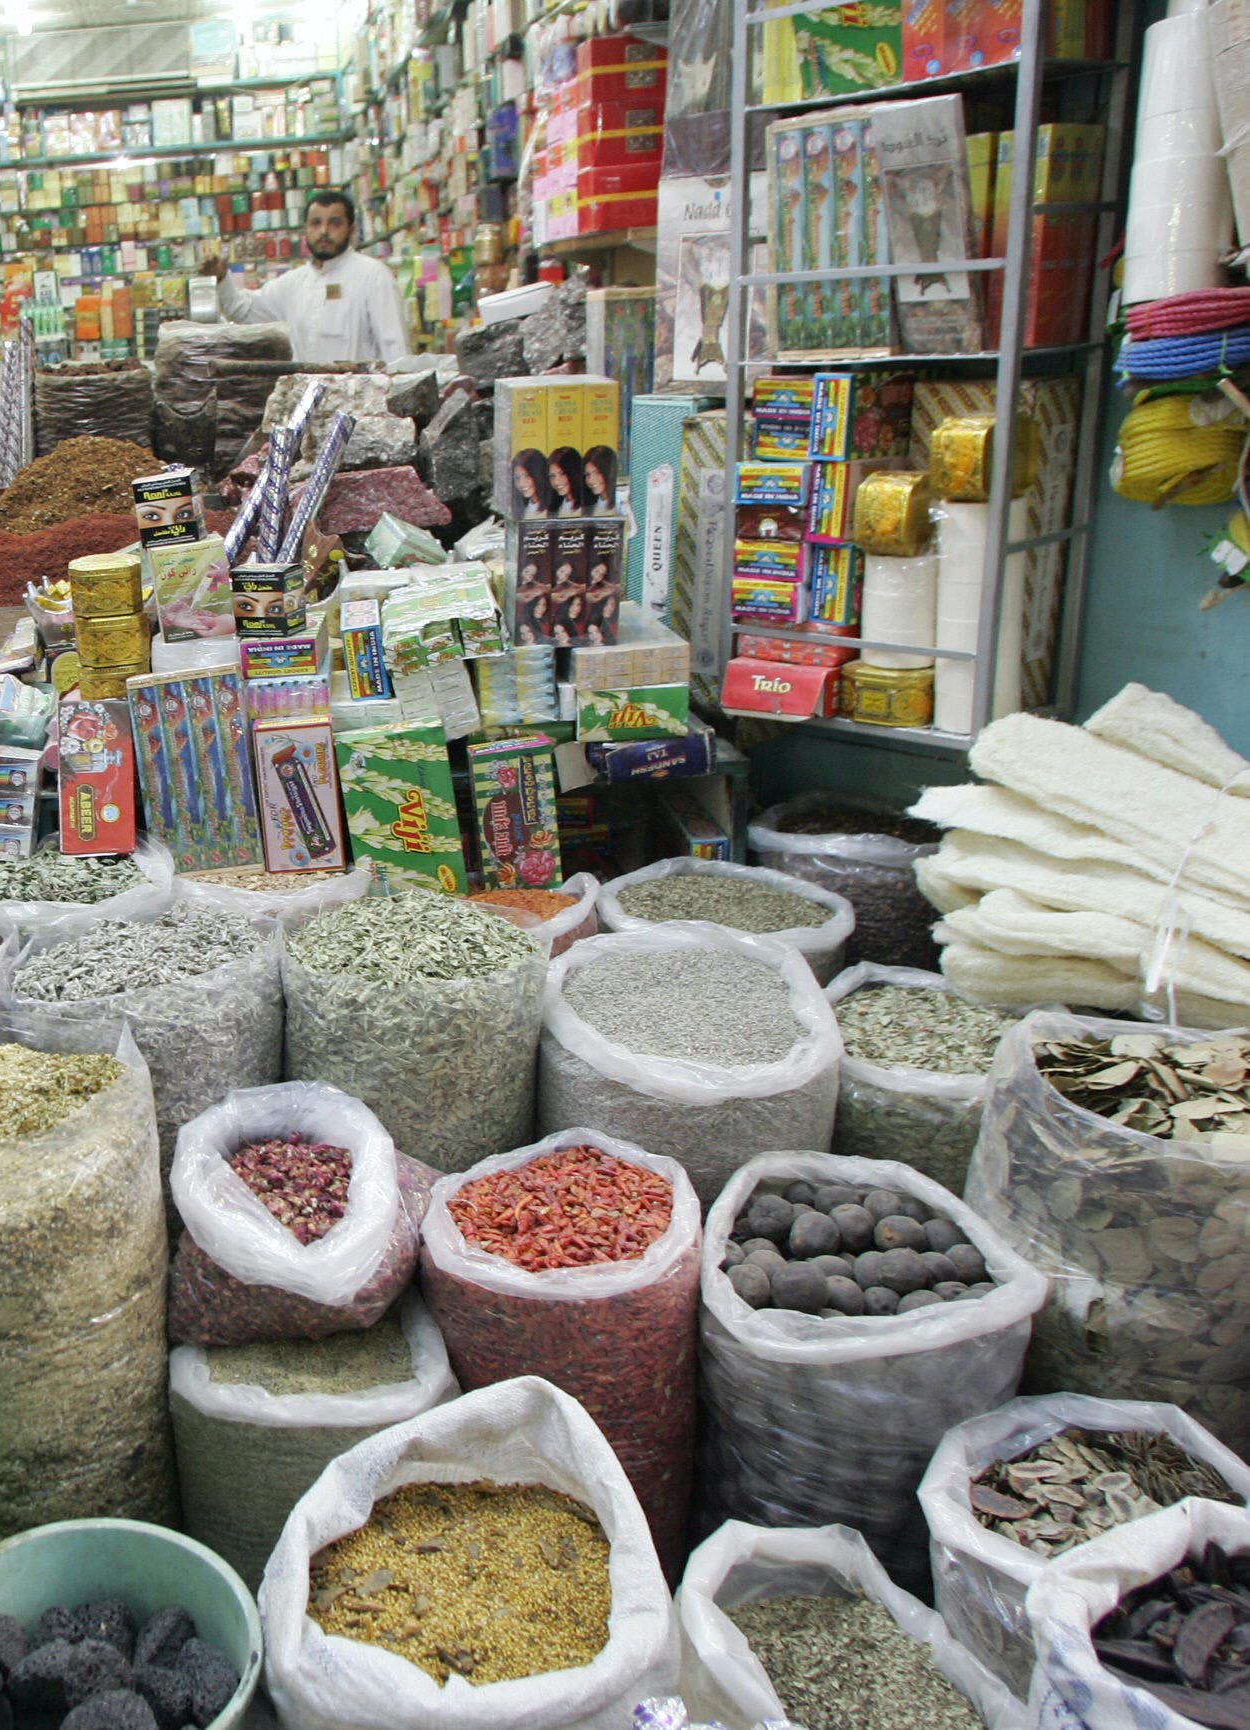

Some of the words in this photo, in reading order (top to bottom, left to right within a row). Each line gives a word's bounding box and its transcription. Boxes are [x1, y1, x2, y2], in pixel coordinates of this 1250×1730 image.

[652, 526, 663, 571] QUEEN
[369, 630, 378, 656] INDIA
[372, 657, 380, 669] IN
[374, 673, 384, 693] MADE
[608, 703, 657, 729] Viji
[630, 755, 686, 776] SANDESH
[80, 791, 94, 833] ABEER
[397, 789, 431, 854] Viji
